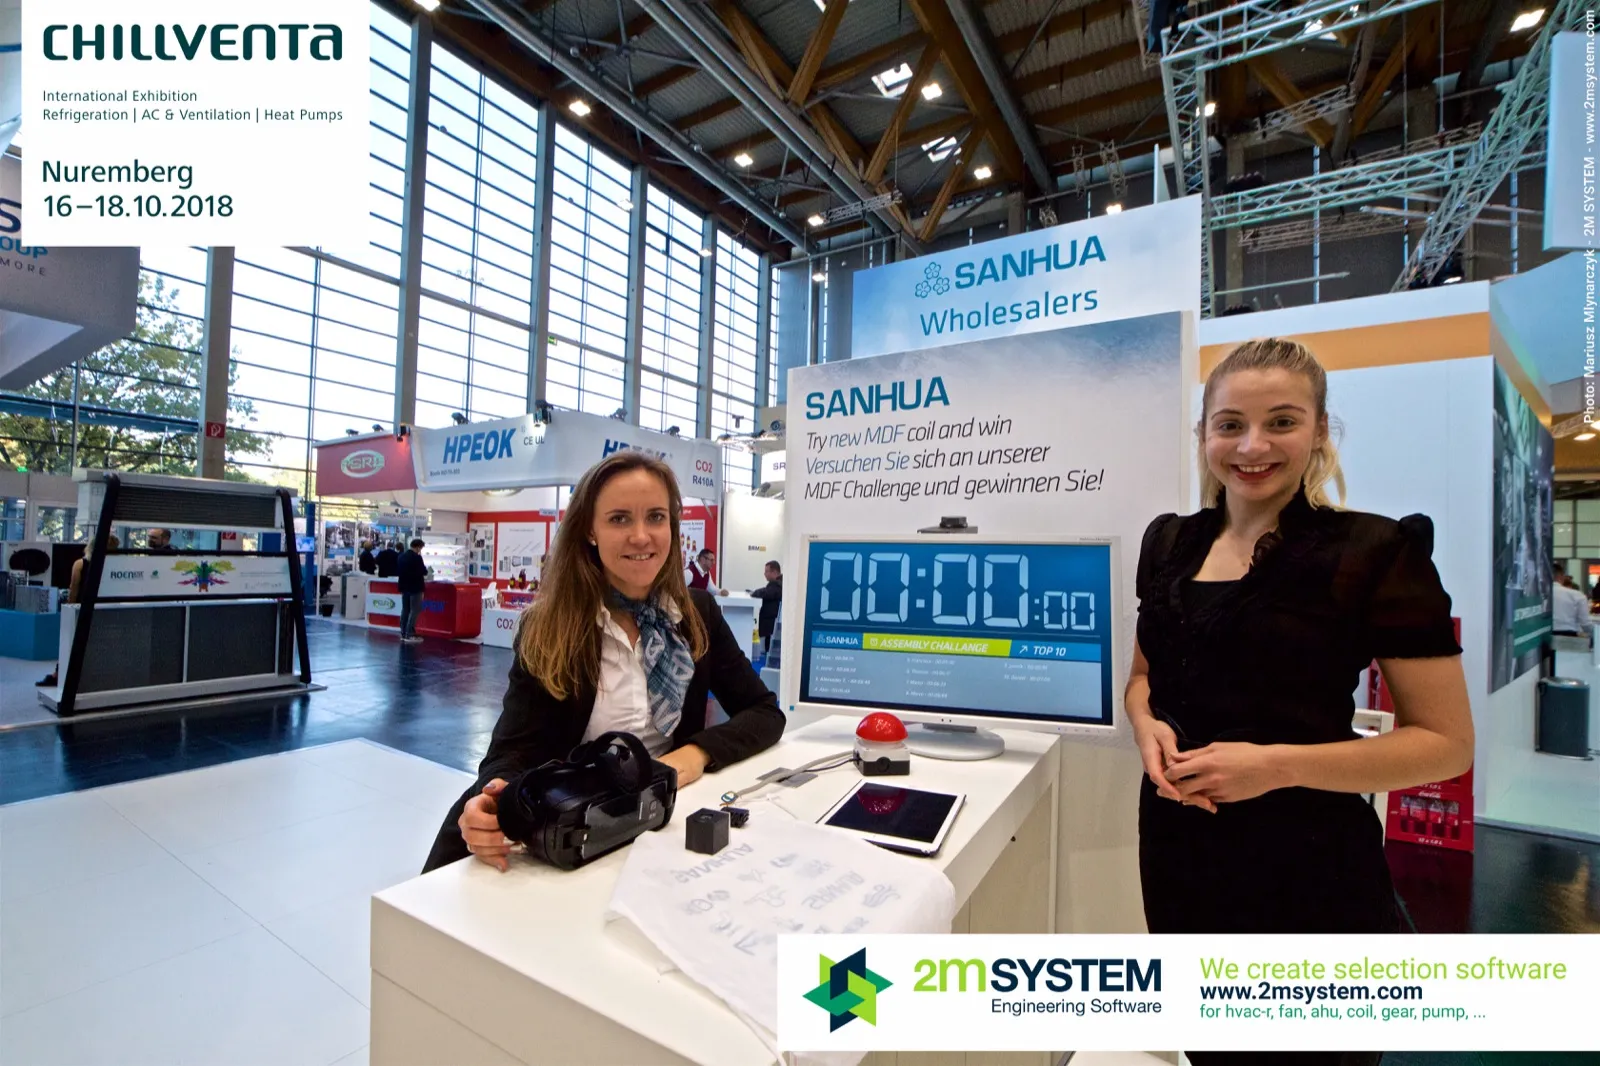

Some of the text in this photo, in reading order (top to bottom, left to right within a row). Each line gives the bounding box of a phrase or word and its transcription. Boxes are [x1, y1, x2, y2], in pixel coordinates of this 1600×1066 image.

[955, 235, 1107, 289] SANHUA
[920, 290, 1098, 336] Wholesalers
[805, 376, 950, 420] SANHUA
[442, 428, 516, 464] HPEOK
[807, 414, 1012, 453] Try new MDF coil and win
[695, 459, 713, 474] CO2
[806, 445, 1051, 474] Versuchen Sie sich an unserer
[692, 475, 714, 488] R410A
[804, 469, 1105, 502] MDF Challenge und gewinnen Sie!
[497, 618, 513, 630] CO2
[826, 635, 1067, 657] SANHUA ASSEMBLY CHALLANGE TOP 10
